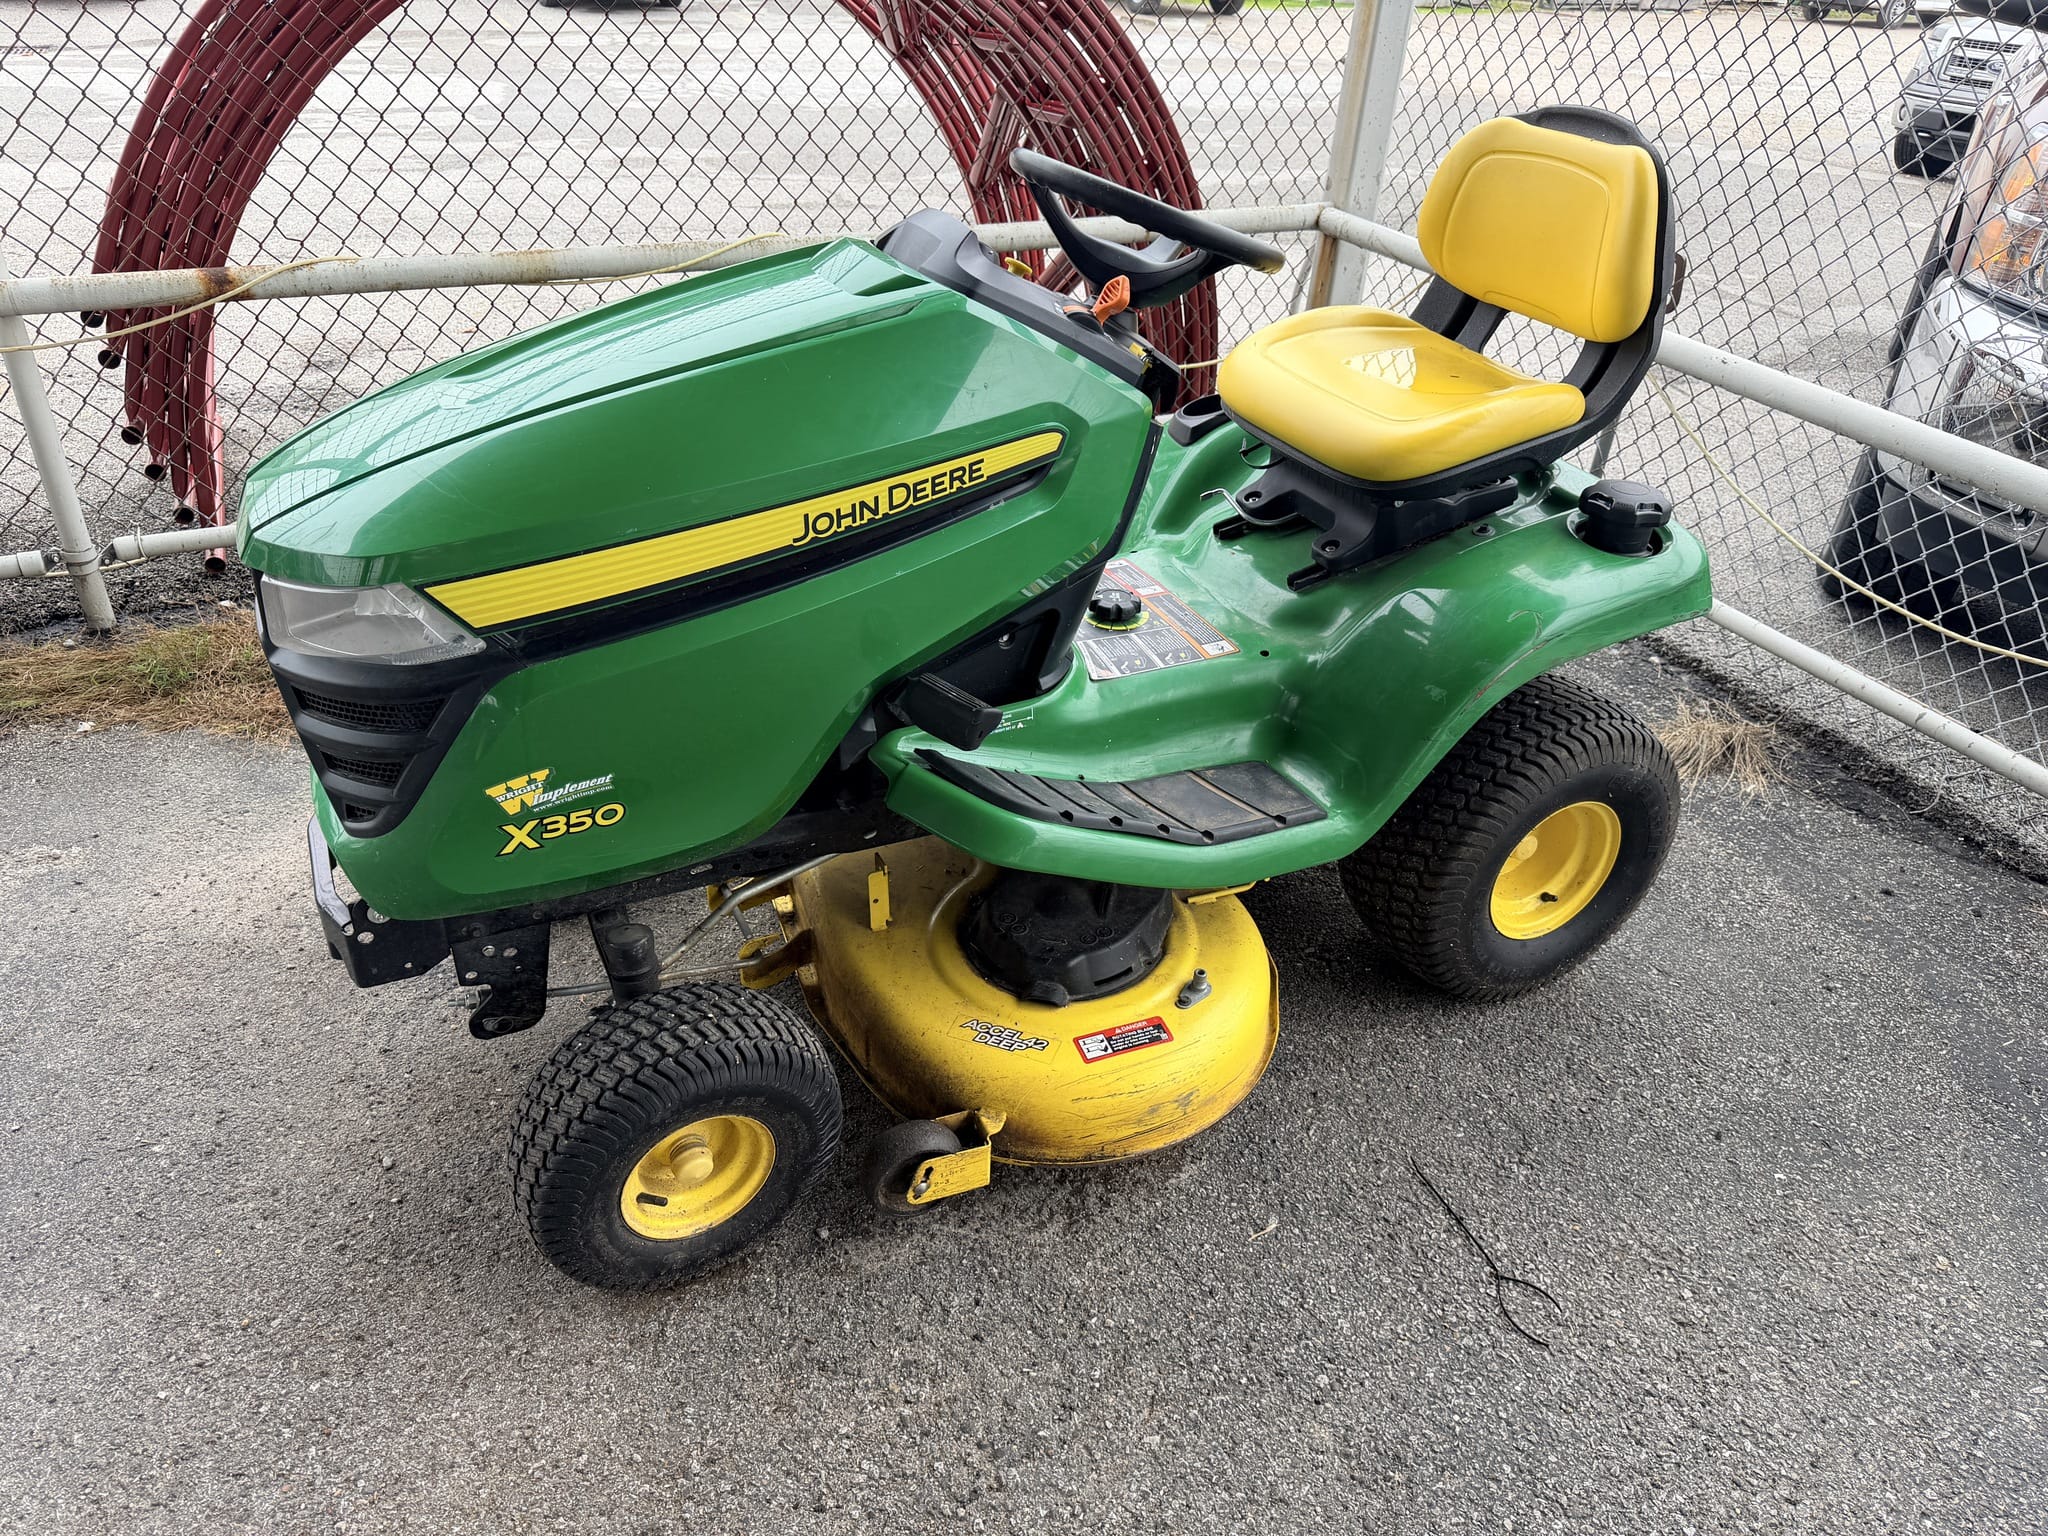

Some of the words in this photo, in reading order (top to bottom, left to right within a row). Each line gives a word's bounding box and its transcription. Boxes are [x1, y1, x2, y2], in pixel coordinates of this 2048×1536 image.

[793, 495, 880, 544] JOHN
[887, 458, 986, 512] DEERE
[495, 780, 545, 804] WRIGHT
[531, 773, 614, 807] Implement
[495, 802, 626, 857] X350
[960, 1018, 1023, 1043] ACCEL
[1020, 1037, 1050, 1052] 42
[972, 1030, 1028, 1053] DEEP
